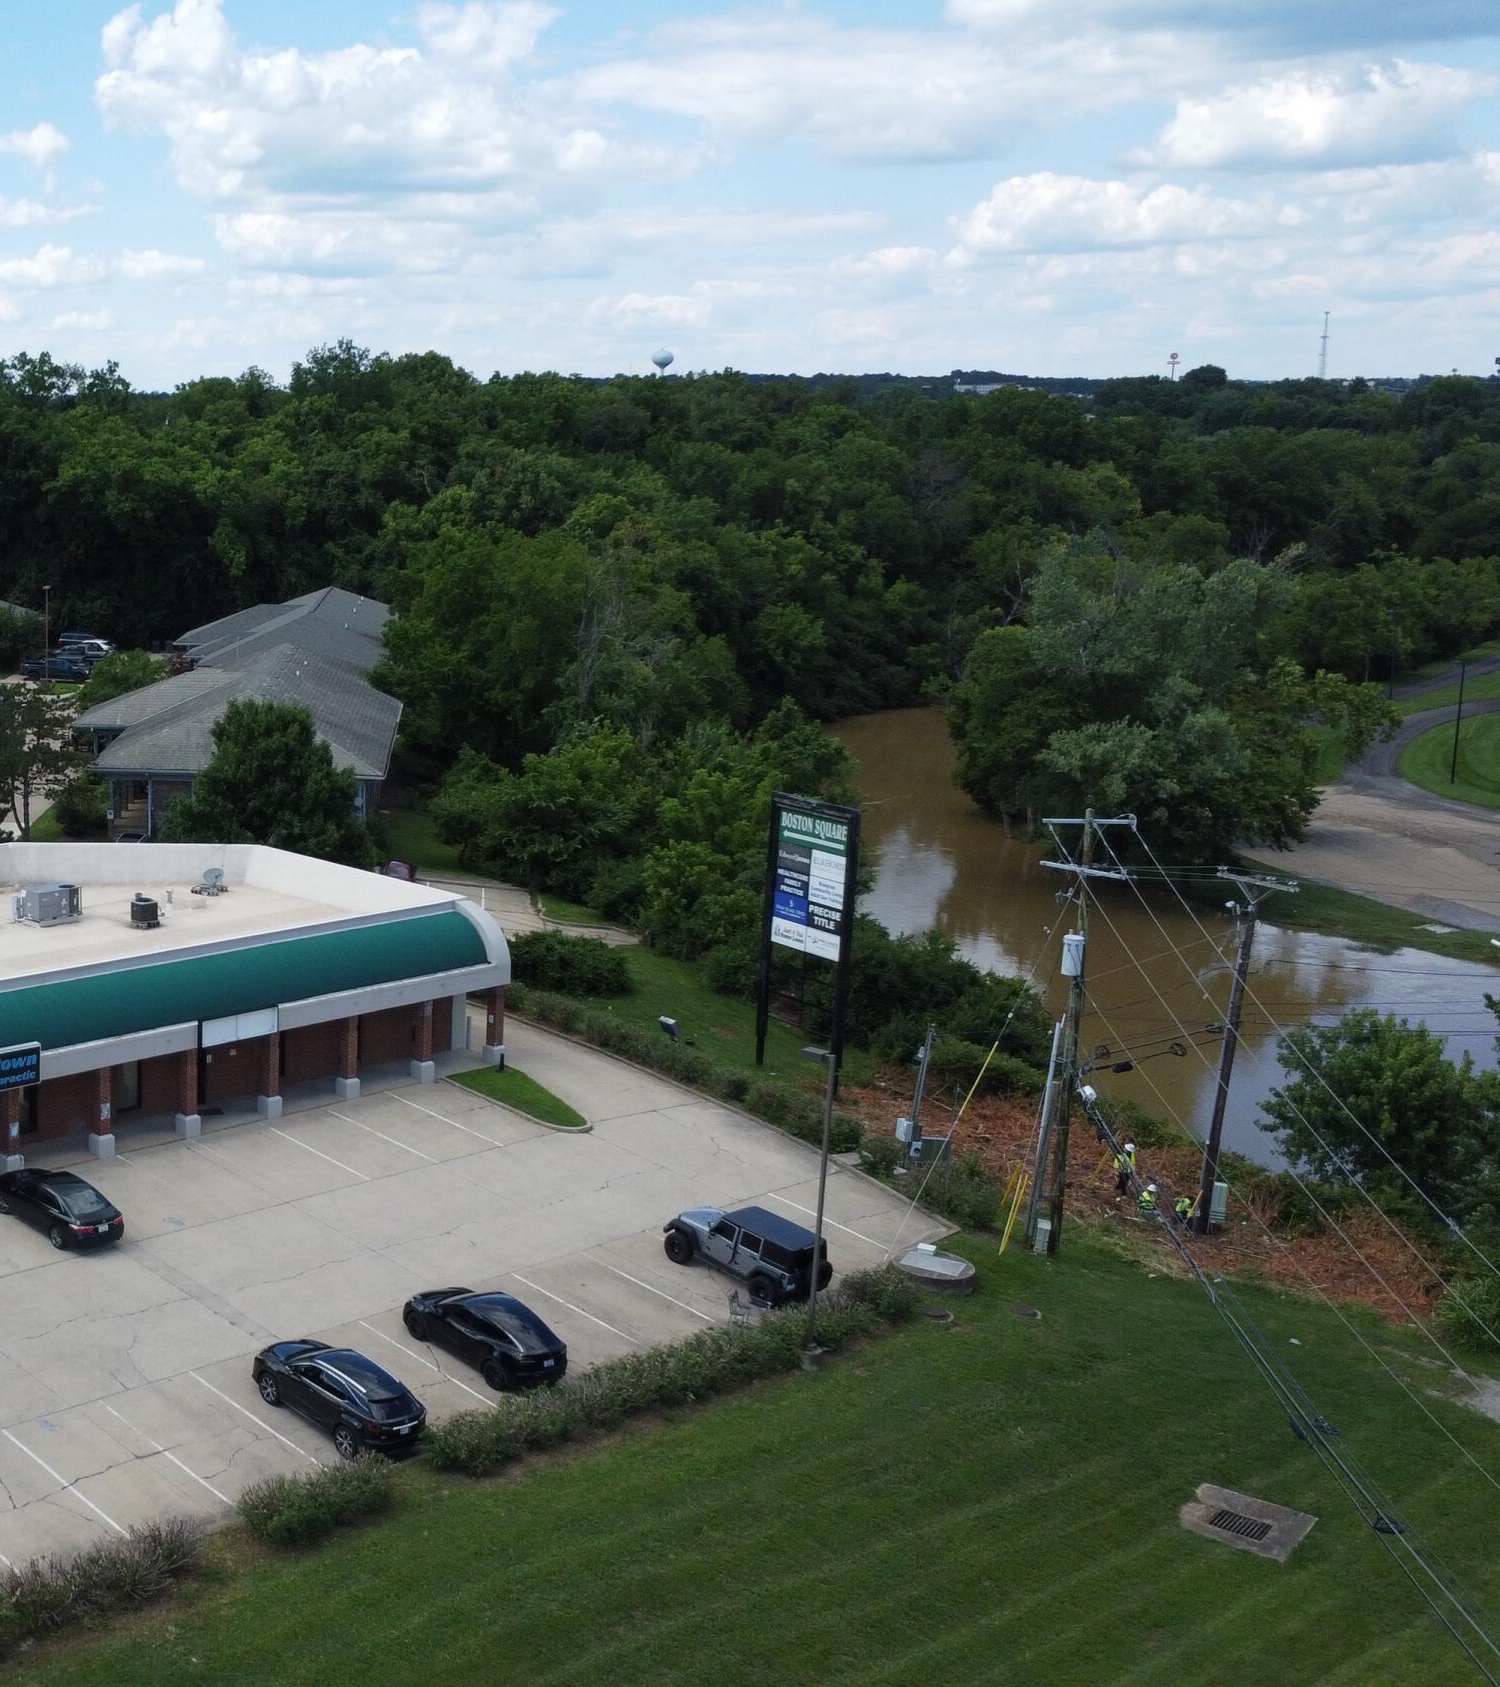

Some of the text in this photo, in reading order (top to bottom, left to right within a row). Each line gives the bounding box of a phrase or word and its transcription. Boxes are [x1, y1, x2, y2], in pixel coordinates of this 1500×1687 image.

[781, 811, 848, 841] BOSTON SQUARE
[809, 904, 842, 921] PRECISE
[813, 916, 835, 930] TITLE
